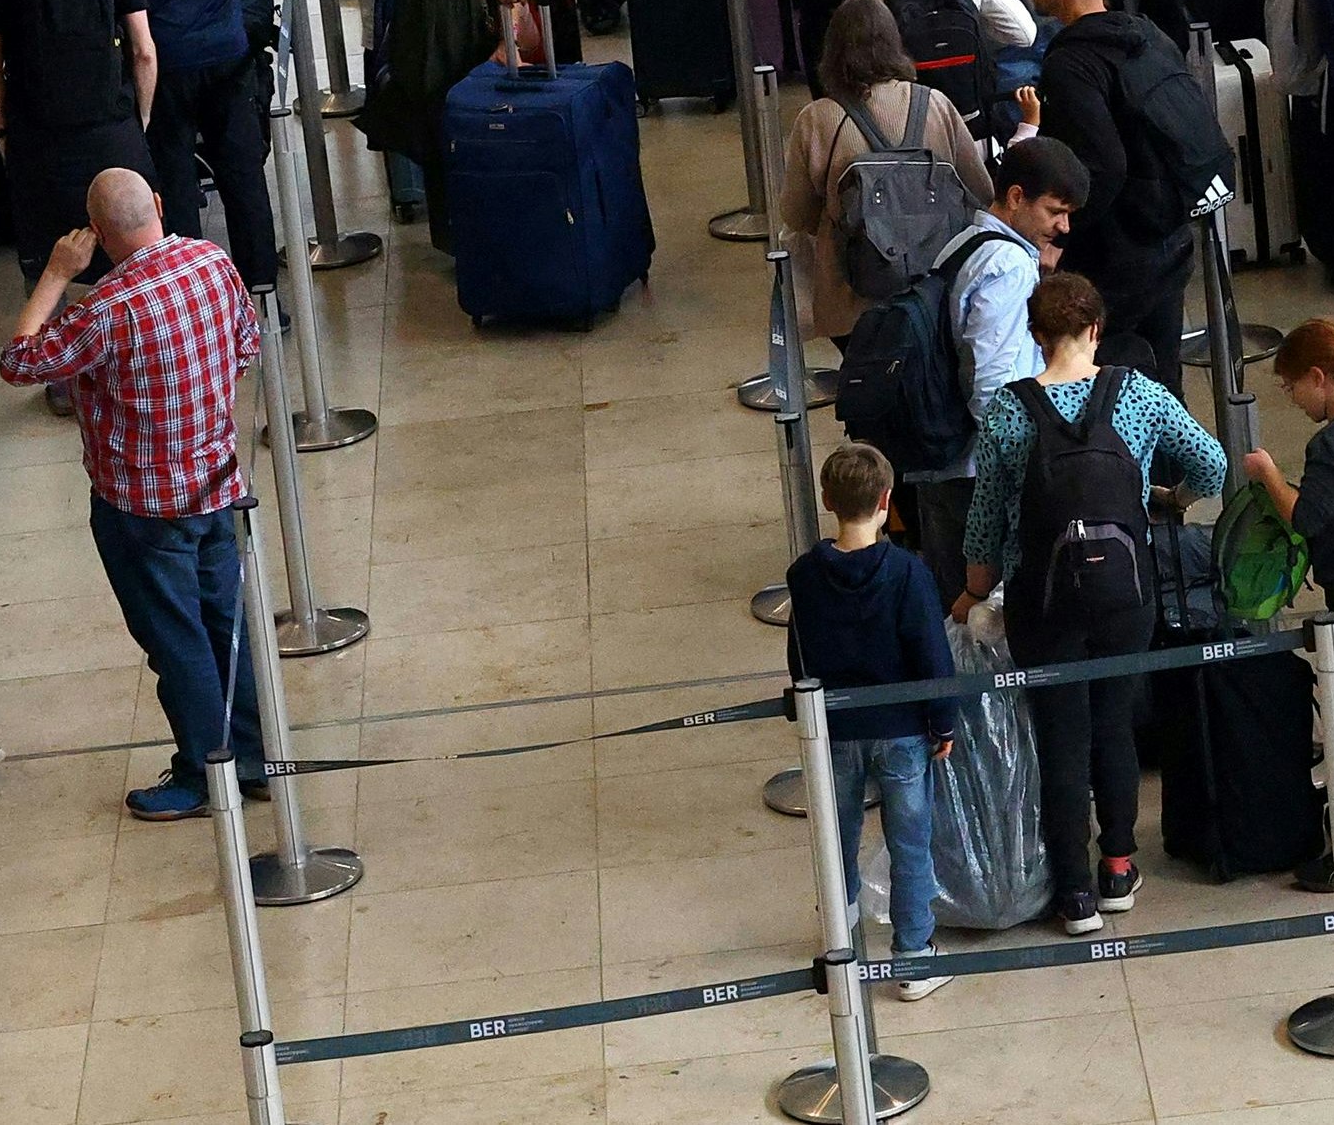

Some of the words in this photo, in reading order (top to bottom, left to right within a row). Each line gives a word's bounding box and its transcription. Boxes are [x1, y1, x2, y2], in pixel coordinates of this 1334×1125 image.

[1190, 191, 1234, 217] adidas
[1202, 642, 1235, 660] BER
[994, 671, 1027, 688] BER
[683, 711, 715, 727] BER
[264, 761, 297, 776] BER
[1091, 941, 1128, 959] BER
[858, 963, 892, 981] BER
[703, 984, 739, 1004] BER
[470, 1019, 506, 1039] BER
